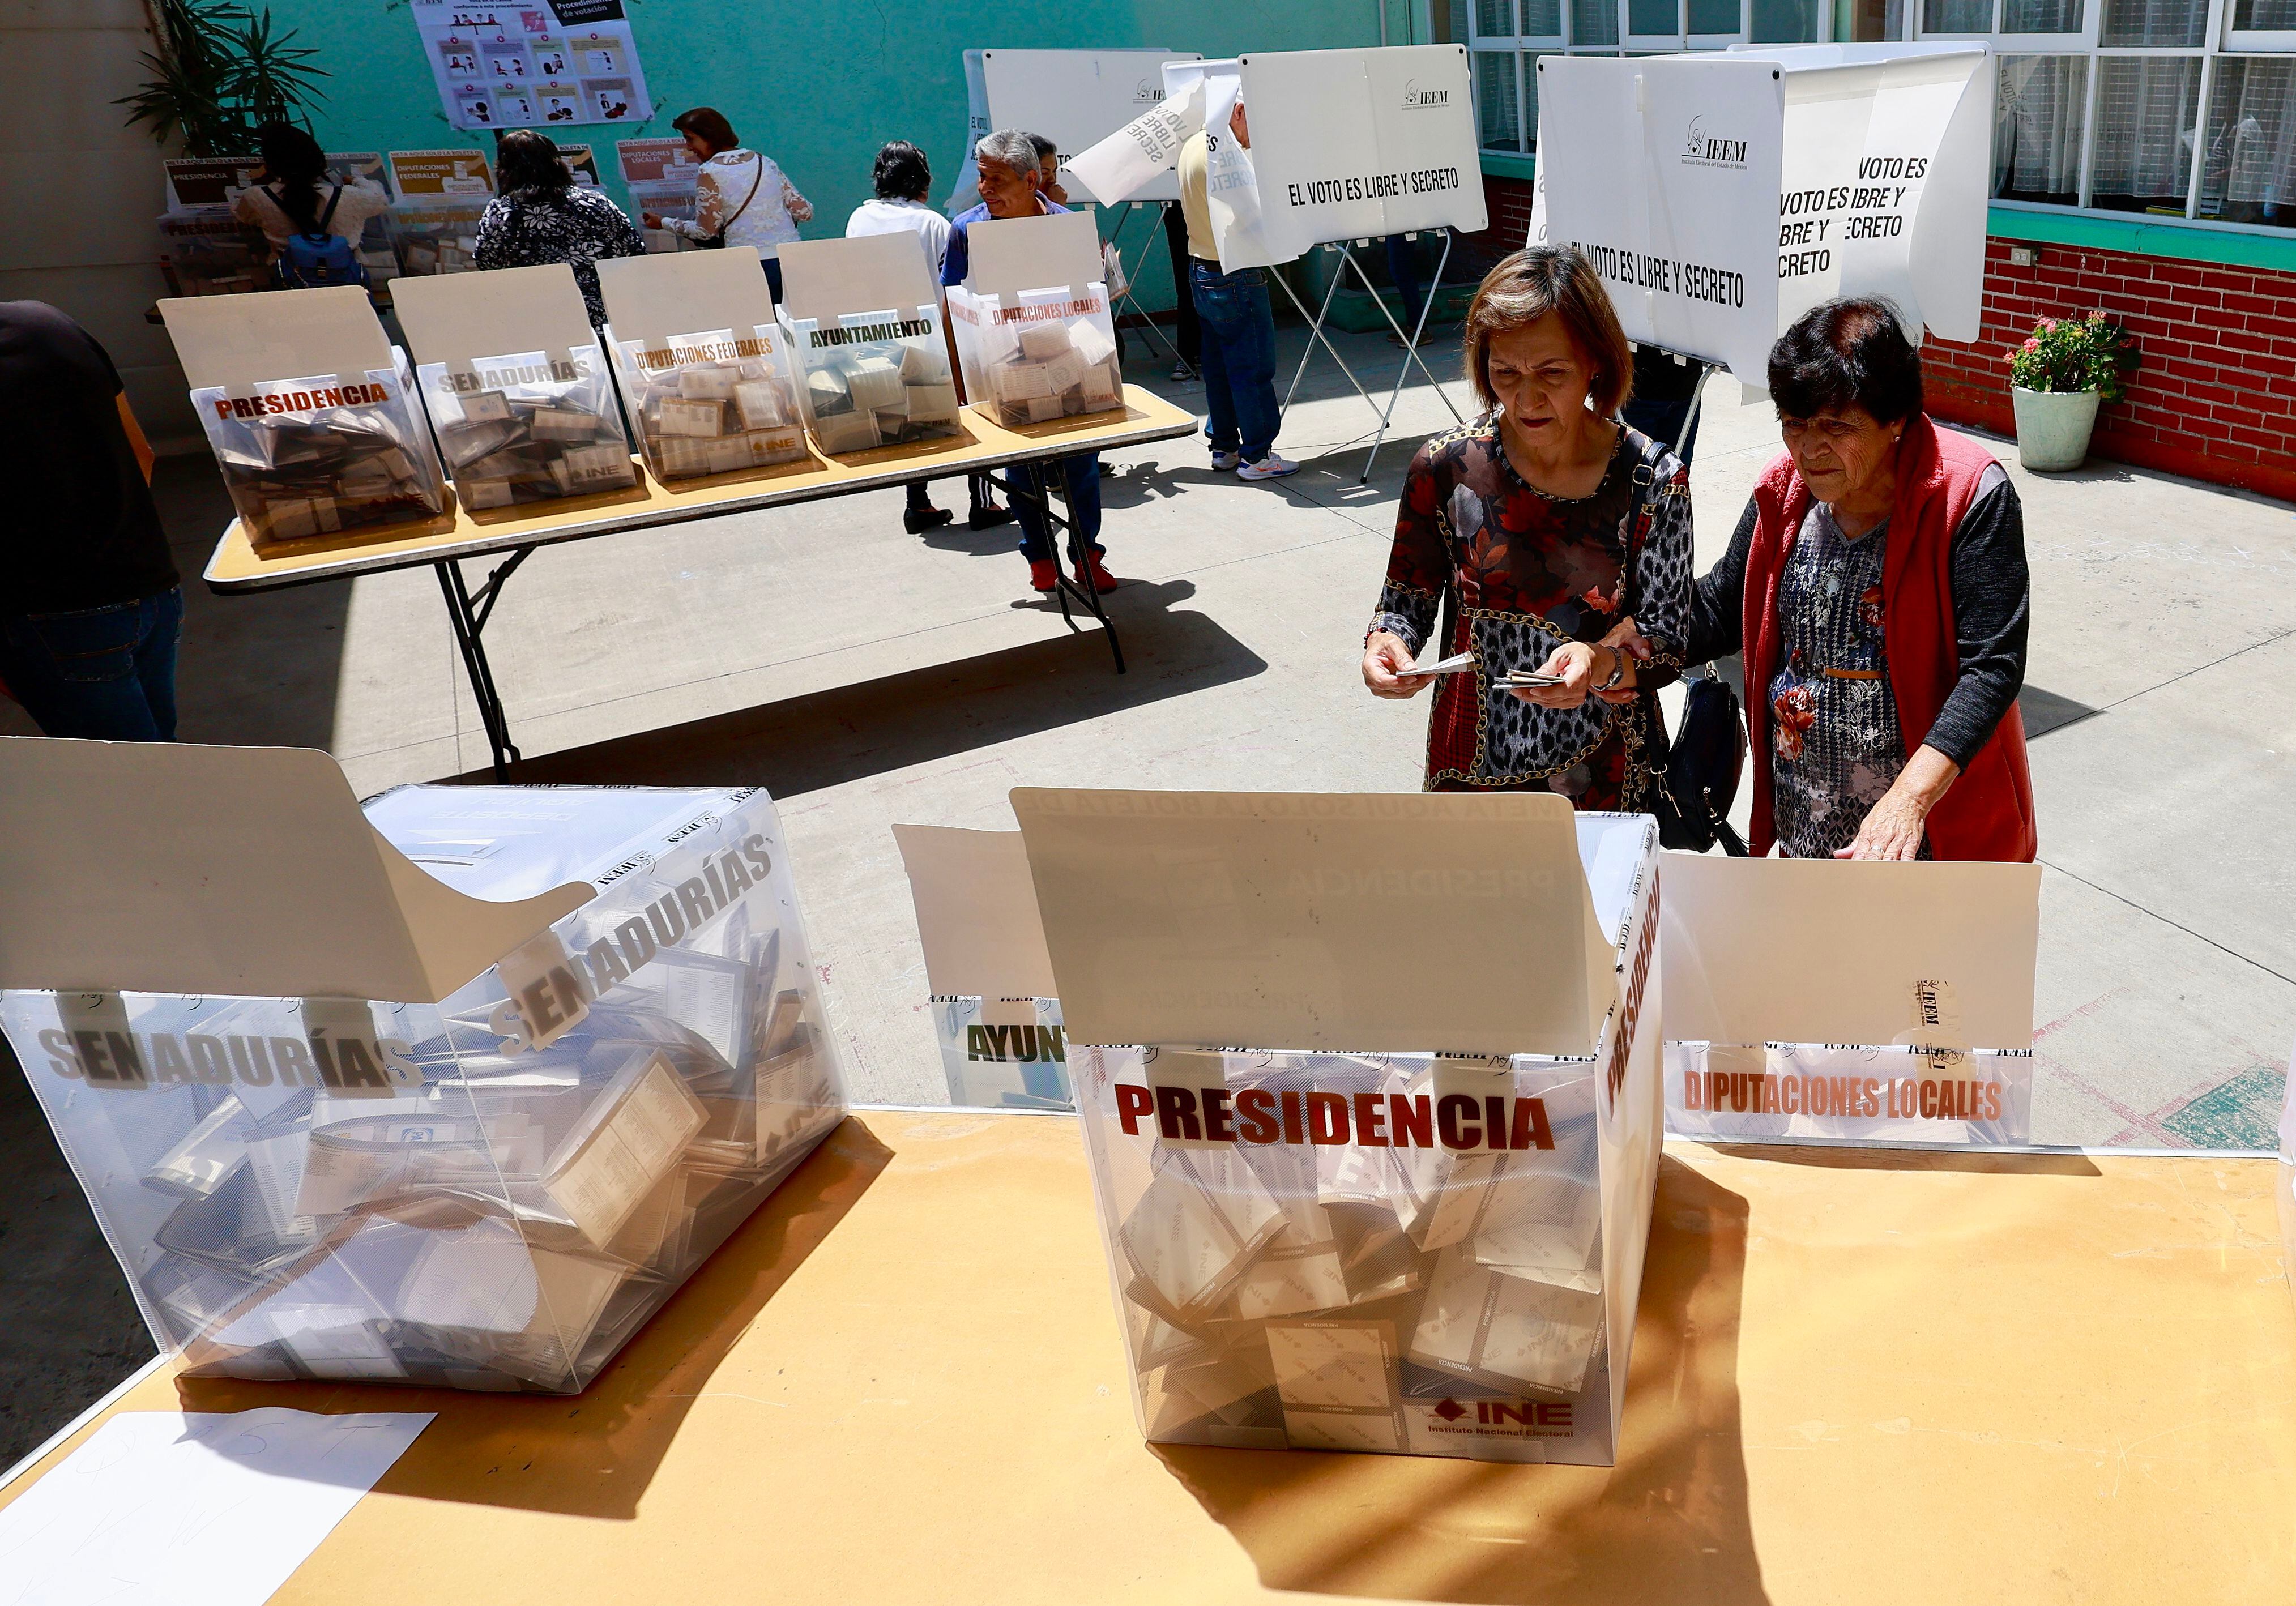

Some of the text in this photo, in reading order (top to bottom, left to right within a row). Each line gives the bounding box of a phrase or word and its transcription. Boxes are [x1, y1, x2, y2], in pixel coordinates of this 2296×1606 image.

[575, 5, 607, 15] votación
[1420, 91, 1448, 104] IEEM
[1706, 139, 1747, 162] IEEM
[1859, 157, 1928, 179] VOTO ES
[1288, 167, 1459, 206] EL VOTO ES LIBRE Y SECRETO
[1780, 186, 1850, 216] VOTO ES
[1850, 186, 1906, 209] IBRE Y
[1779, 219, 1830, 247] BRE Y
[1587, 244, 1744, 309] VOTO ES LIBRE Y SECRETO
[1778, 249, 1830, 279] CRETO
[992, 303, 1062, 326] DIPUTACIONES
[1064, 298, 1102, 317] LOCALES
[810, 318, 932, 348] AYUNTAMIENTO
[636, 338, 773, 369] DIPUTACIONES FEDERALES
[438, 360, 591, 394] SENADURÍAS
[215, 383, 389, 420] PRESIDENCIA
[764, 437, 796, 451] INE
[585, 464, 620, 477] INE
[598, 862, 637, 885] IEEM
[490, 832, 772, 1057] SENADURÍAS
[1923, 991, 1939, 1025] IEEM
[37, 1027, 424, 1088] SENADURÍAS
[966, 1025, 1068, 1063] AYUN
[1684, 1070, 2003, 1121] DIPUTACIONES LOCALES
[1113, 1084, 1555, 1151] PRESIDENCIA
[1340, 1193, 1376, 1202] PRESIDENCIA
[1439, 1359, 1473, 1373] PRESIDENCIA
[1529, 1383, 1564, 1394] PRESIDENCIA
[1477, 1402, 1573, 1426] INE
[234, 1422, 286, 1456] S
[319, 1423, 394, 1462] T
[1428, 1425, 1574, 1437] Instituto Nacional Electoral
